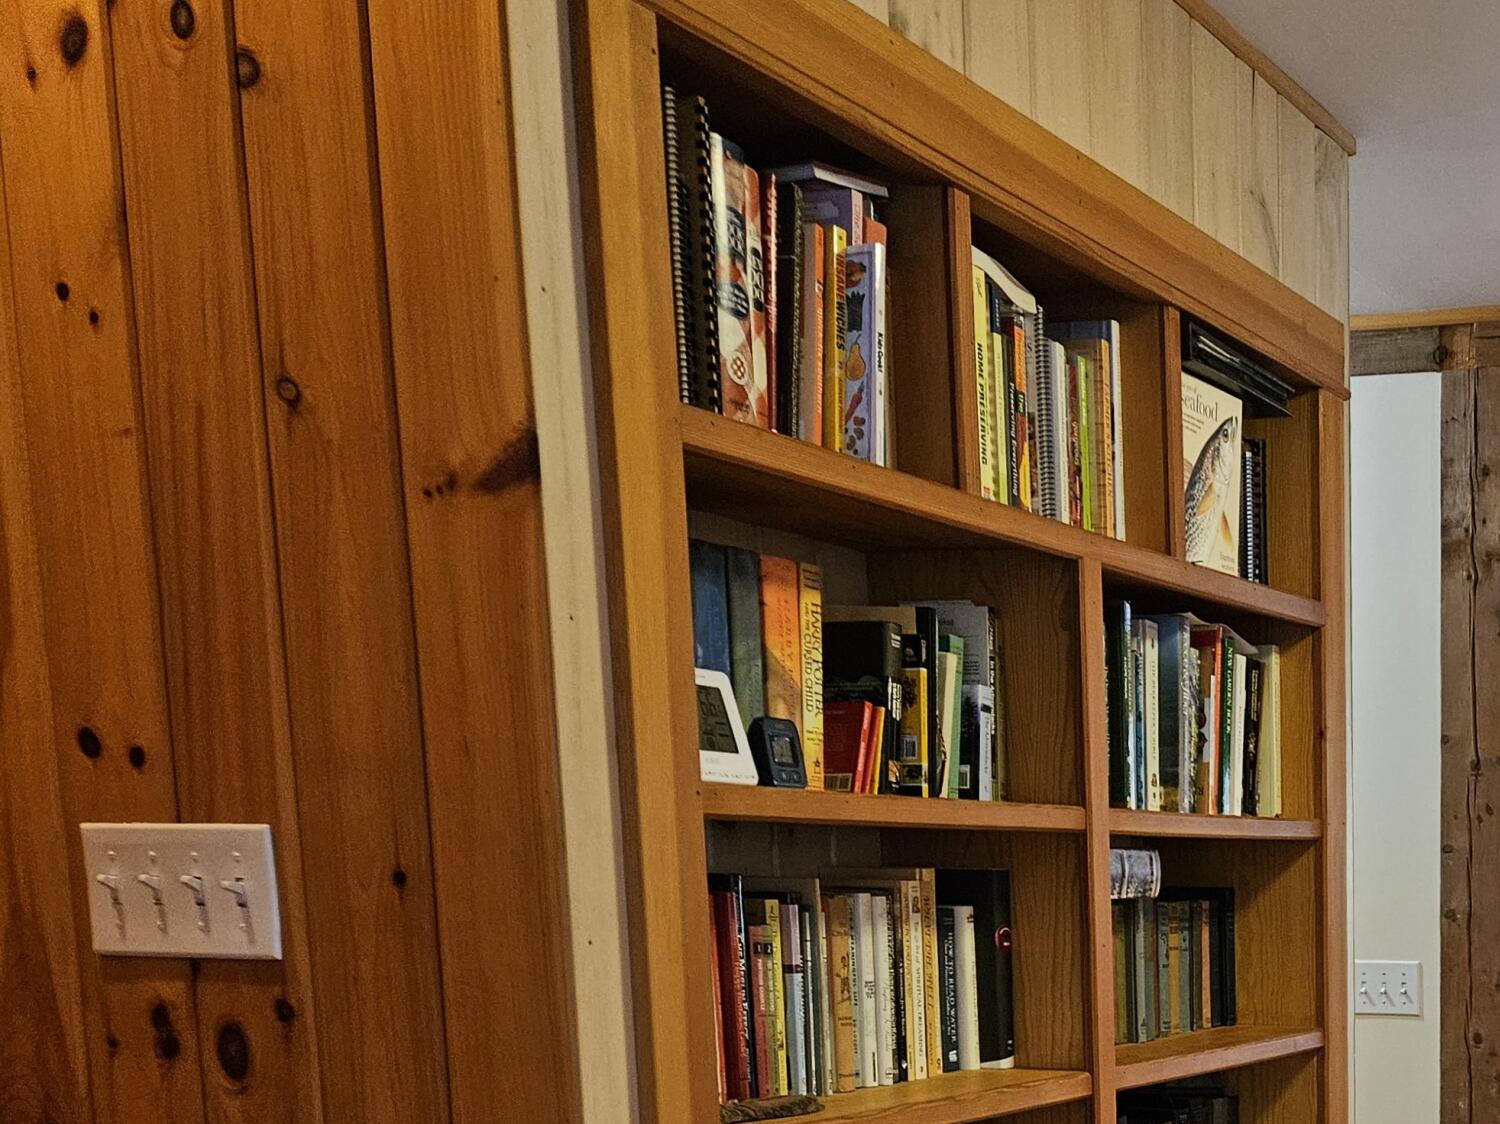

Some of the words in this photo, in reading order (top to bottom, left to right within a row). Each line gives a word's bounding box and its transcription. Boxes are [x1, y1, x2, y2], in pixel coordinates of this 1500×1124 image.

[835, 253, 846, 351] INSANEWICHES
[976, 342, 984, 381] HOME
[978, 383, 988, 465] PRESERVING
[1009, 382, 1018, 438] Preserving
[1183, 394, 1218, 422] eafood
[1011, 440, 1019, 496] Everything
[803, 633, 813, 675] CURSED
[811, 601, 823, 657] HARRY
[804, 677, 814, 713] CHILD
[813, 658, 824, 718] POTTER
[948, 958, 954, 975] TO
